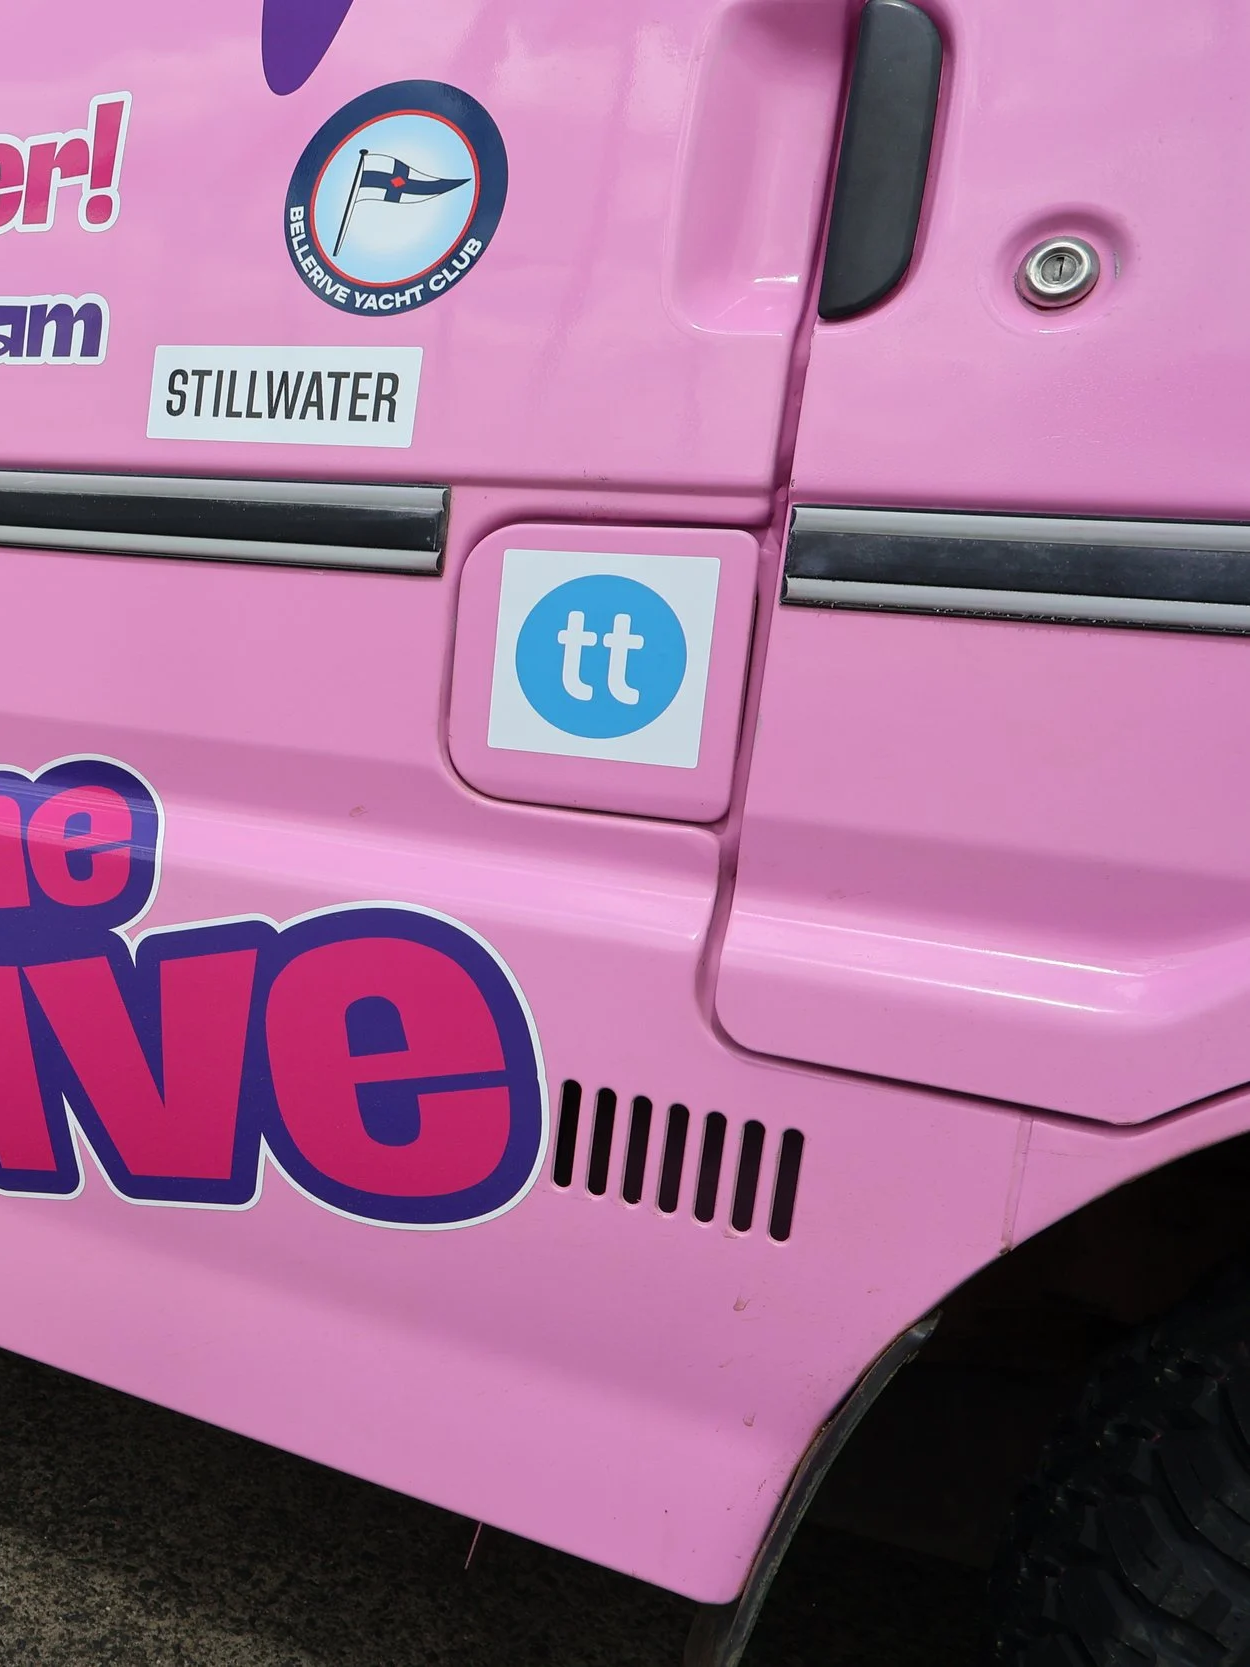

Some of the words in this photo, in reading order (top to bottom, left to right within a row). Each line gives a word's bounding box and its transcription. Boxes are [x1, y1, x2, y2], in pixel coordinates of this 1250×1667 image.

[289, 205, 351, 304] BELLERIVE
[354, 285, 425, 310] YACHT
[428, 237, 484, 292] CLUB
[165, 368, 400, 423] STILLWATER
[557, 610, 645, 705] tt
